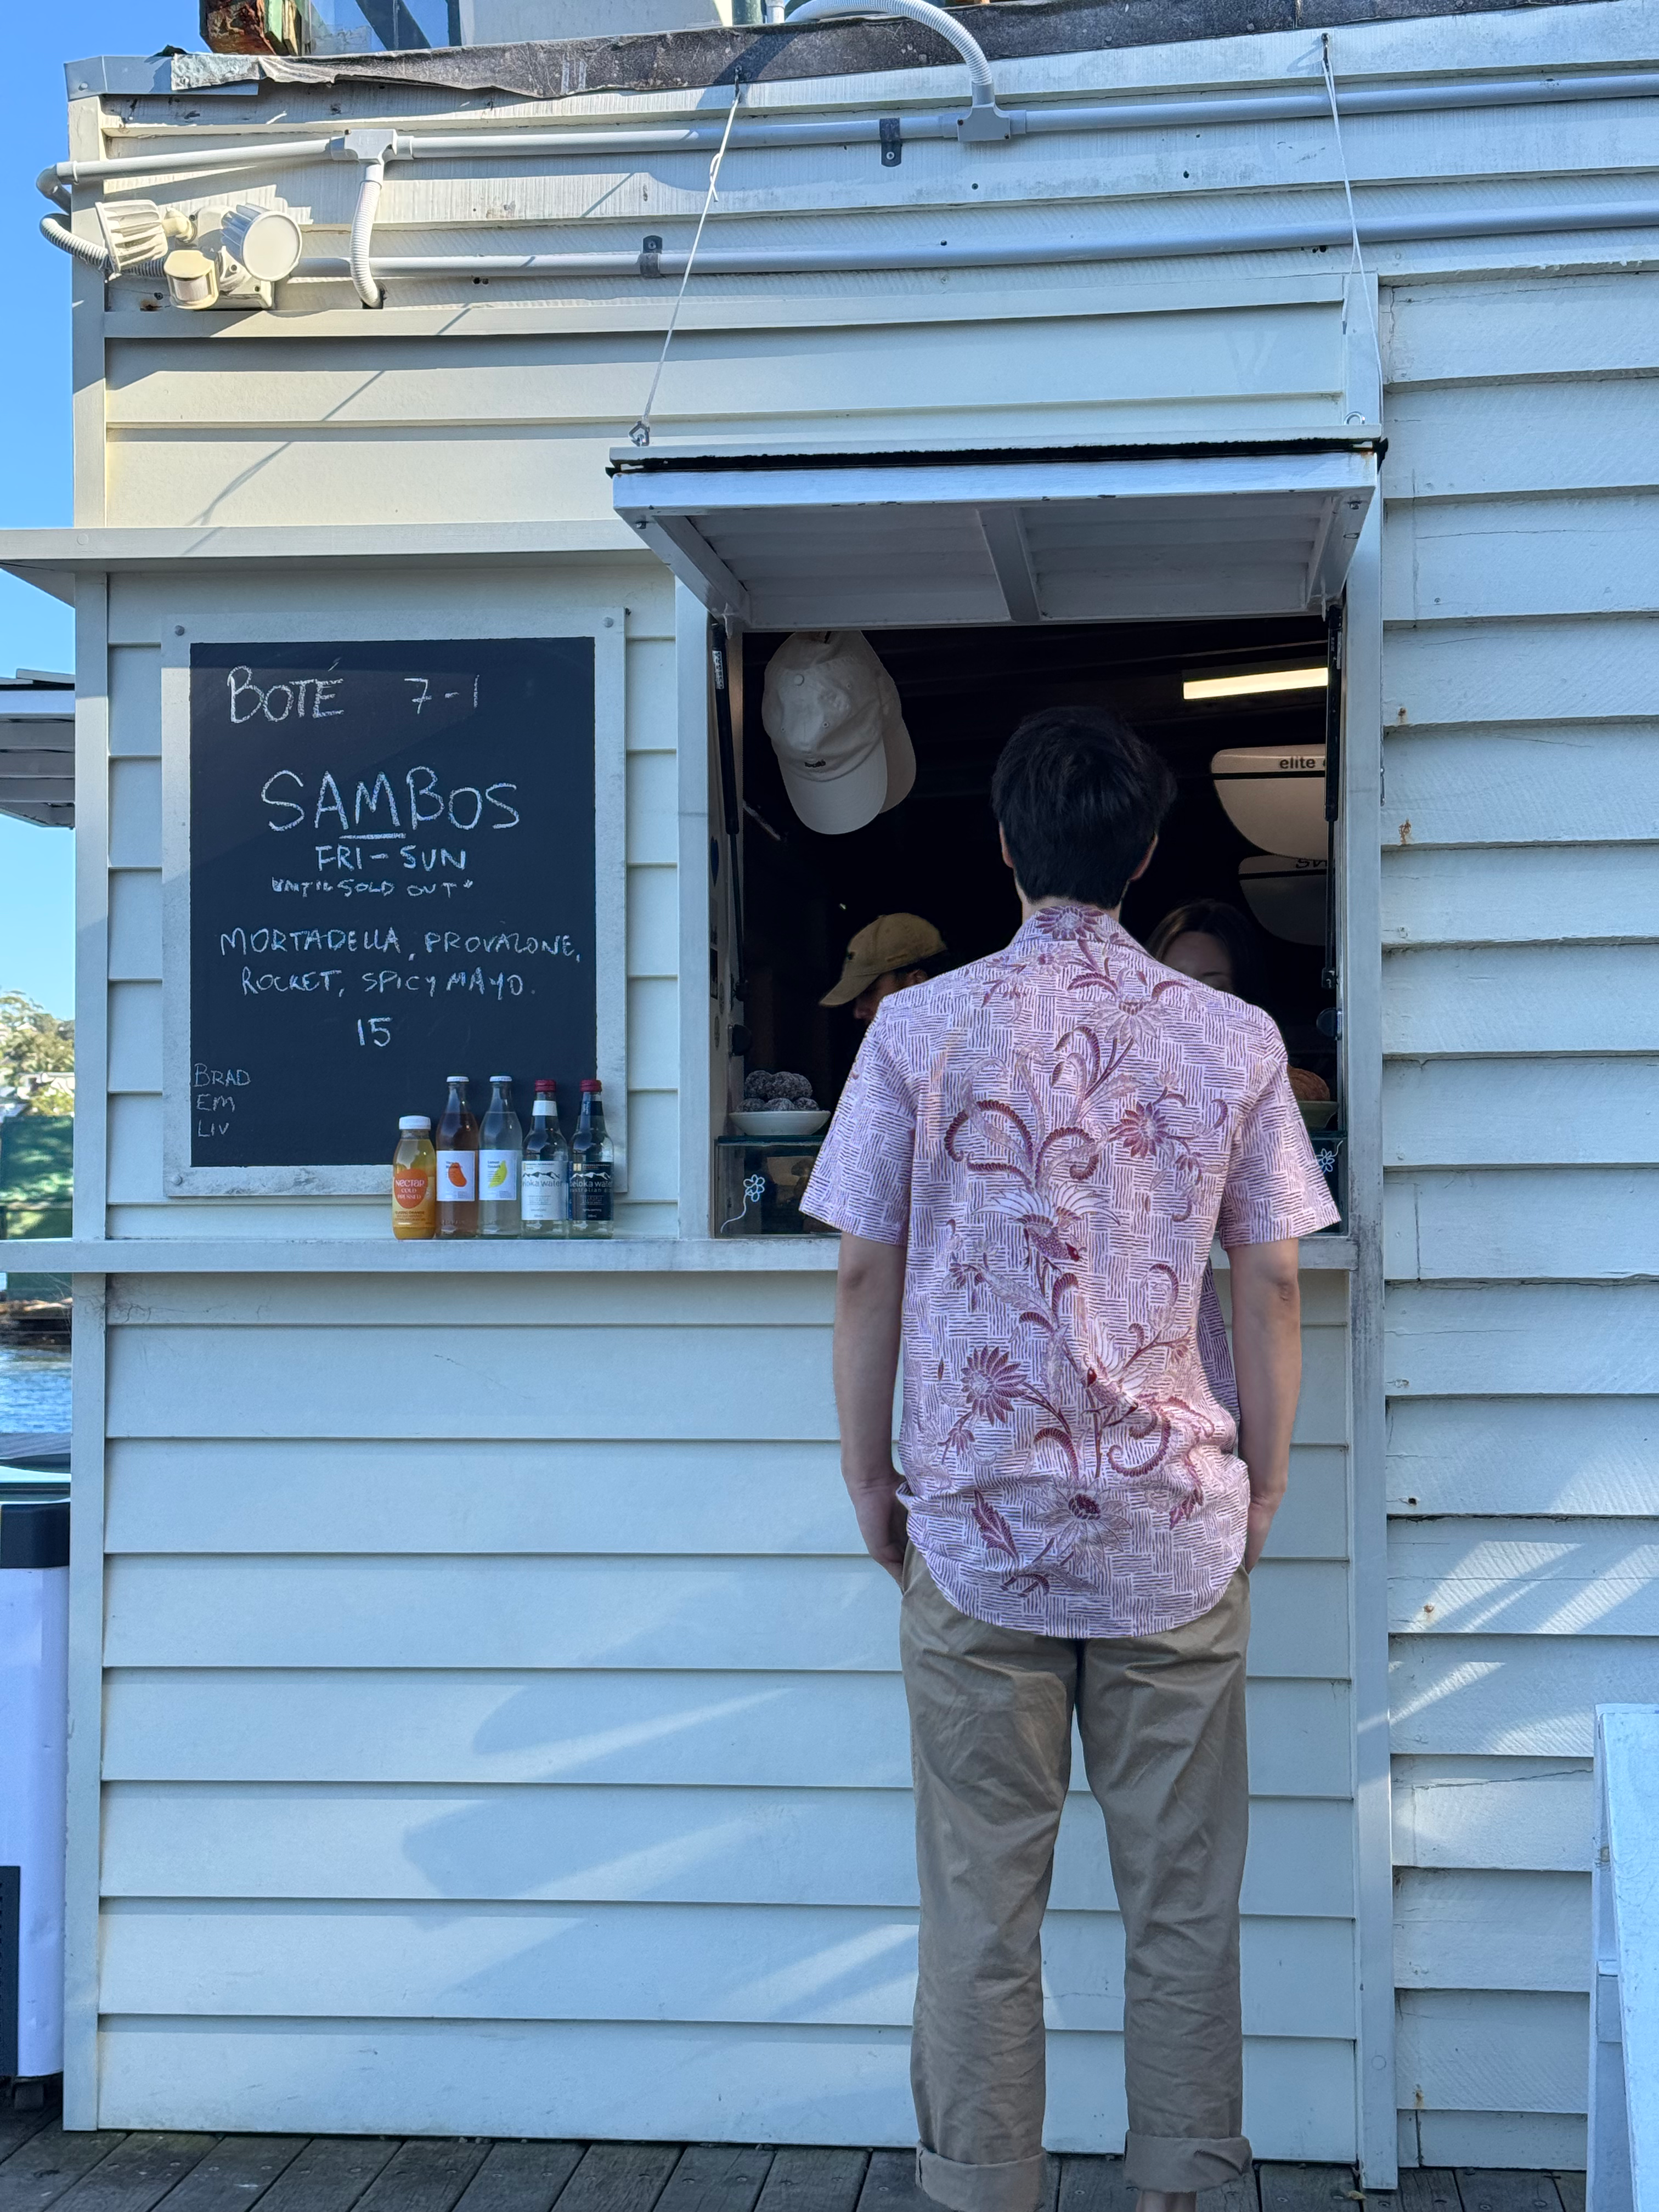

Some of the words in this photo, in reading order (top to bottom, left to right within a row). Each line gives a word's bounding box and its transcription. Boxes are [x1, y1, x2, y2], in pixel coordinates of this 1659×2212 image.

[1279, 757, 1316, 769] elite
[261, 765, 520, 831] SAMBOS
[336, 879, 395, 898] SOLD
[241, 967, 345, 997] ROCKET,
[362, 970, 436, 997] SPICY
[356, 1017, 392, 1047] 15
[193, 1063, 251, 1088] BRAD
